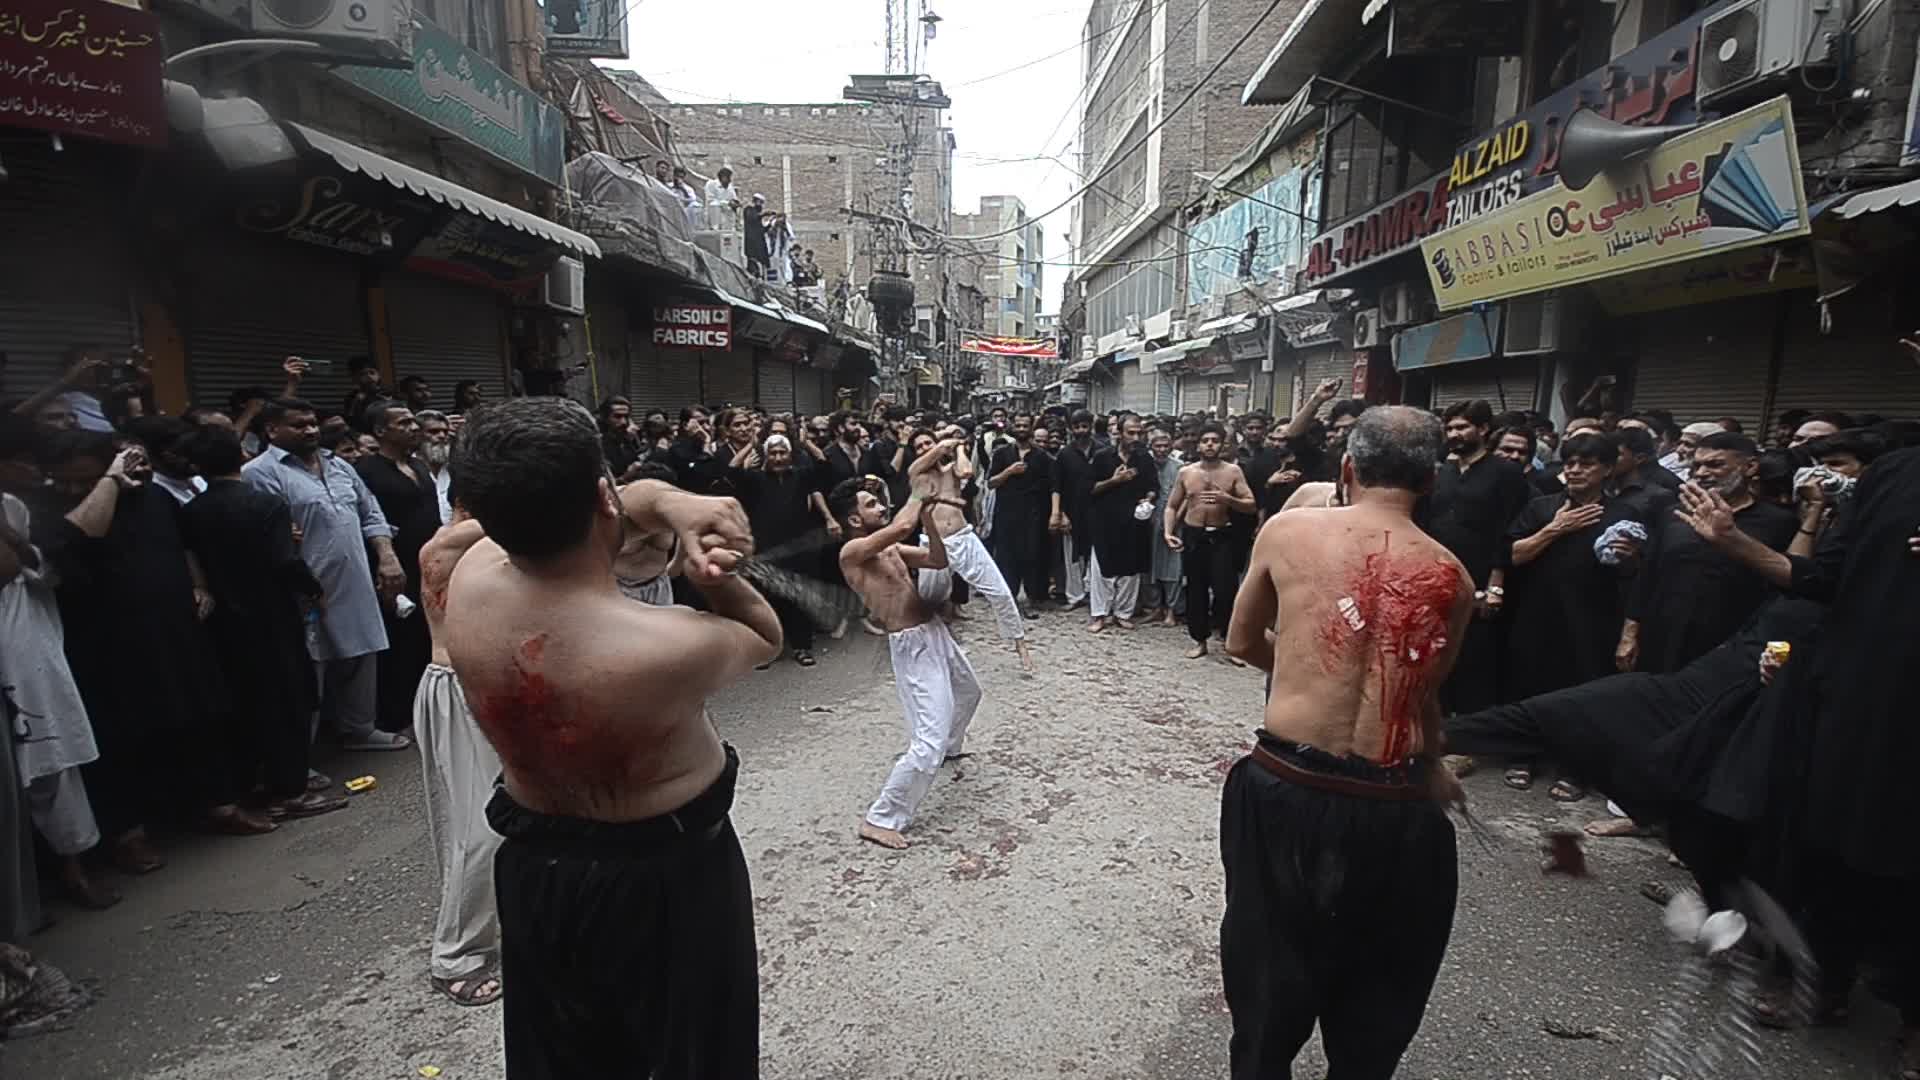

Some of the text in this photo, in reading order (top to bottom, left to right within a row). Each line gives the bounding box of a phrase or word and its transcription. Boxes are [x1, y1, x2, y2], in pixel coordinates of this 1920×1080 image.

[22, 8, 87, 48] فیبرکس
[84, 28, 153, 57] حسنین
[1447, 120, 1529, 192] ALZAID
[1445, 169, 1523, 228] TAILORS
[1588, 160, 1702, 233] عباسی
[1305, 175, 1450, 282] AL-HAMRA
[1454, 217, 1545, 269] ABBASI
[1461, 269, 1494, 286] Fabric
[1496, 263, 1505, 278] &
[1507, 254, 1547, 277] tailors
[653, 307, 711, 324] LARSON
[653, 327, 729, 347] FABRICS
